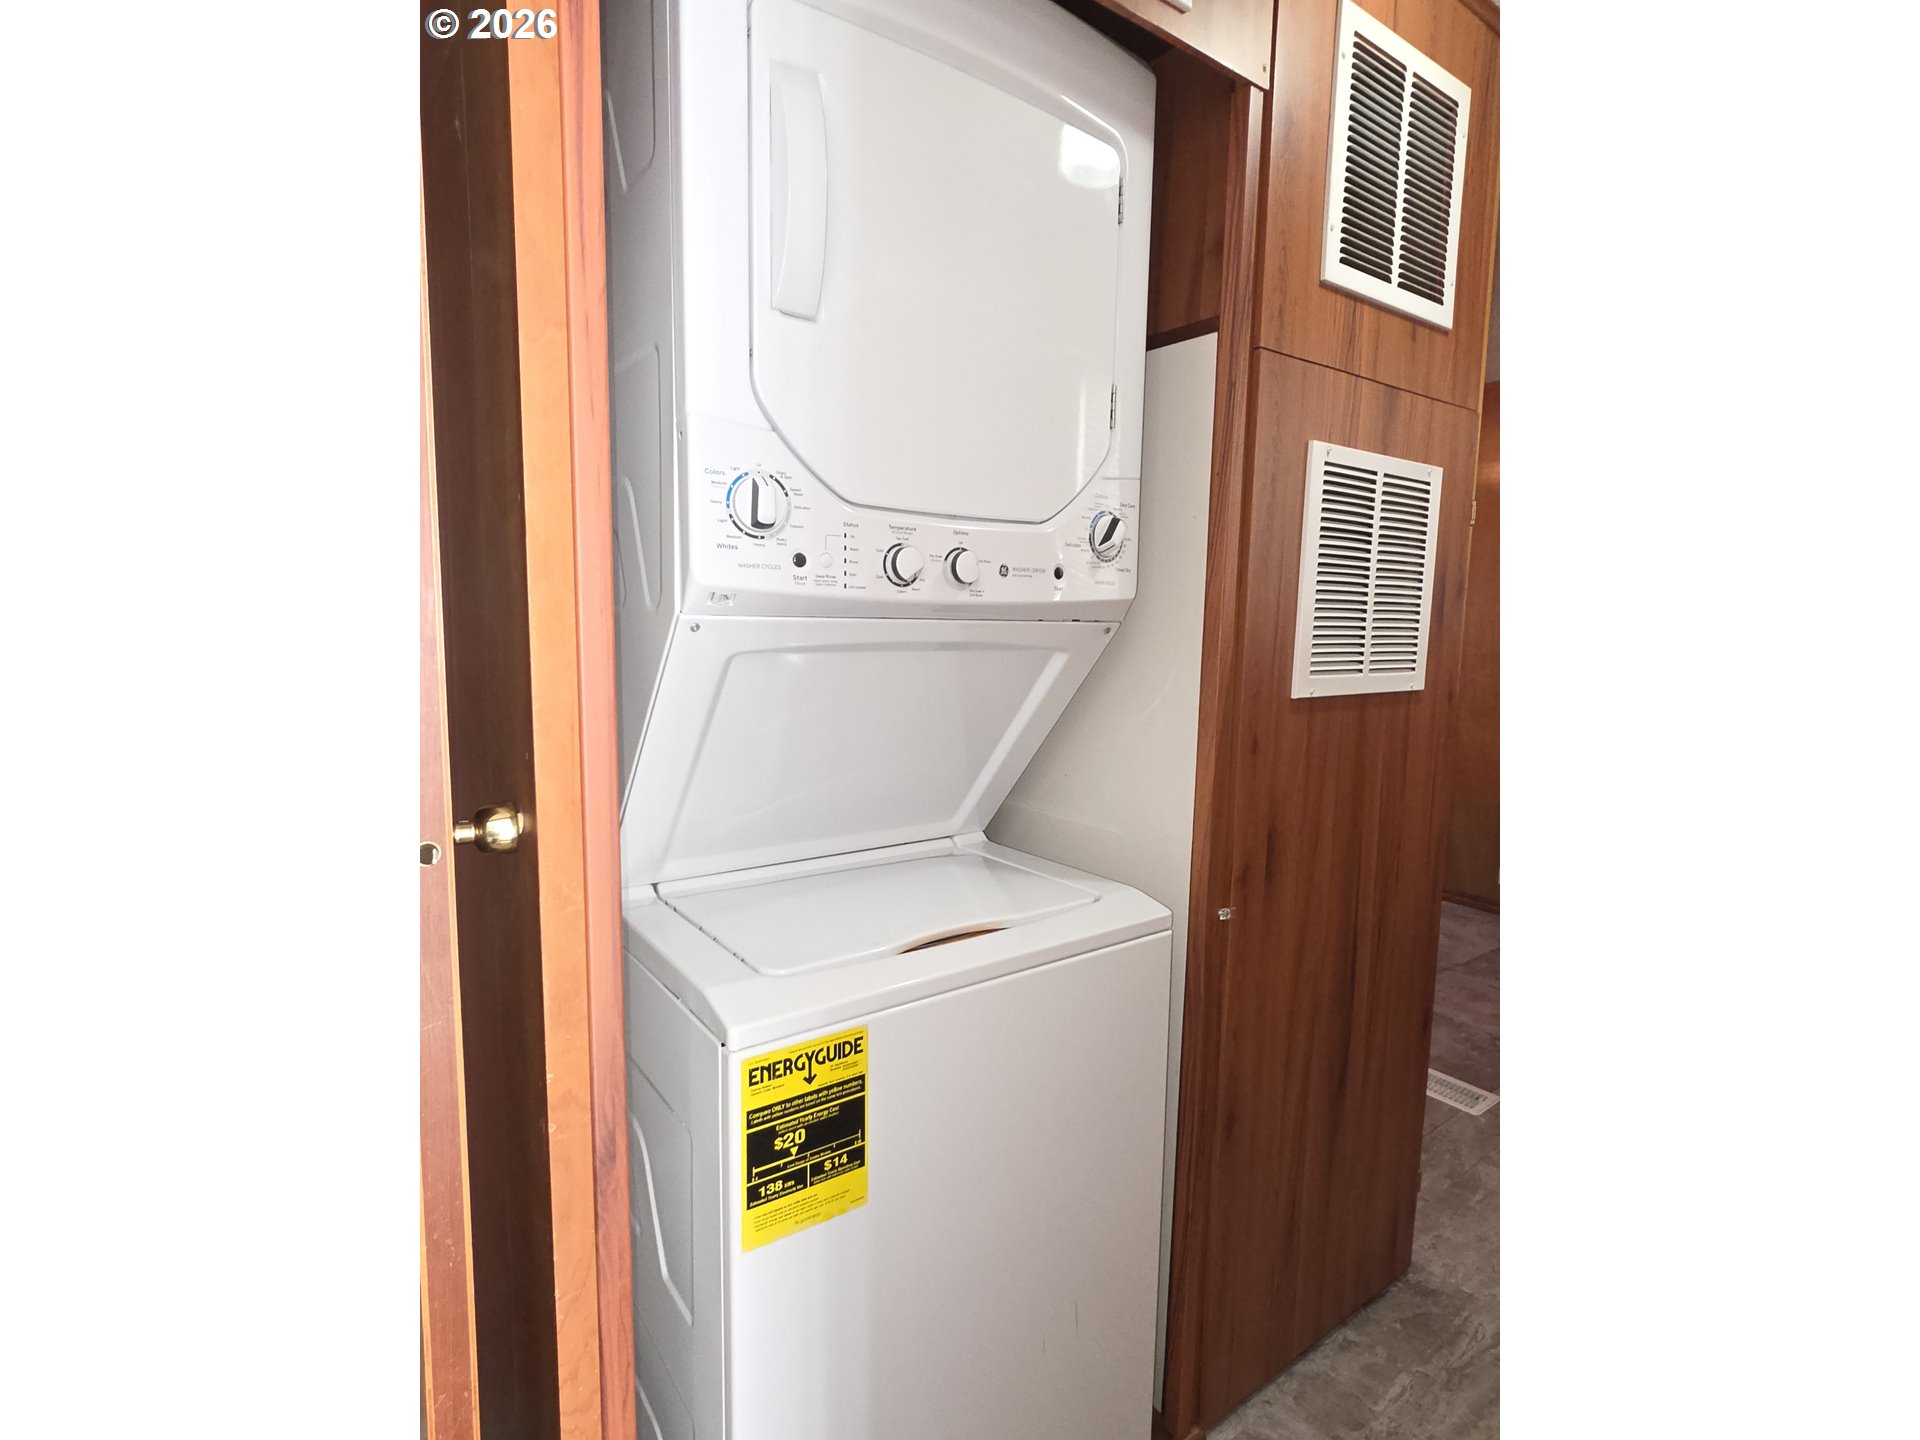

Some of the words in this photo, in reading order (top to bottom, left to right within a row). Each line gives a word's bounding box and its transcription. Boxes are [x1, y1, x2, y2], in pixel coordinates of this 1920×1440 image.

[704, 468, 726, 476] Colors
[888, 524, 917, 532] Temperature
[737, 562, 759, 570] WASHER
[760, 563, 782, 571] CYCLES
[748, 1036, 864, 1087] ENERGYGUIDE
[749, 1108, 772, 1120] Compare
[771, 1103, 786, 1113] ONLY
[774, 1128, 806, 1151] $20
[824, 1153, 848, 1171] $14
[758, 1180, 783, 1197] 138
